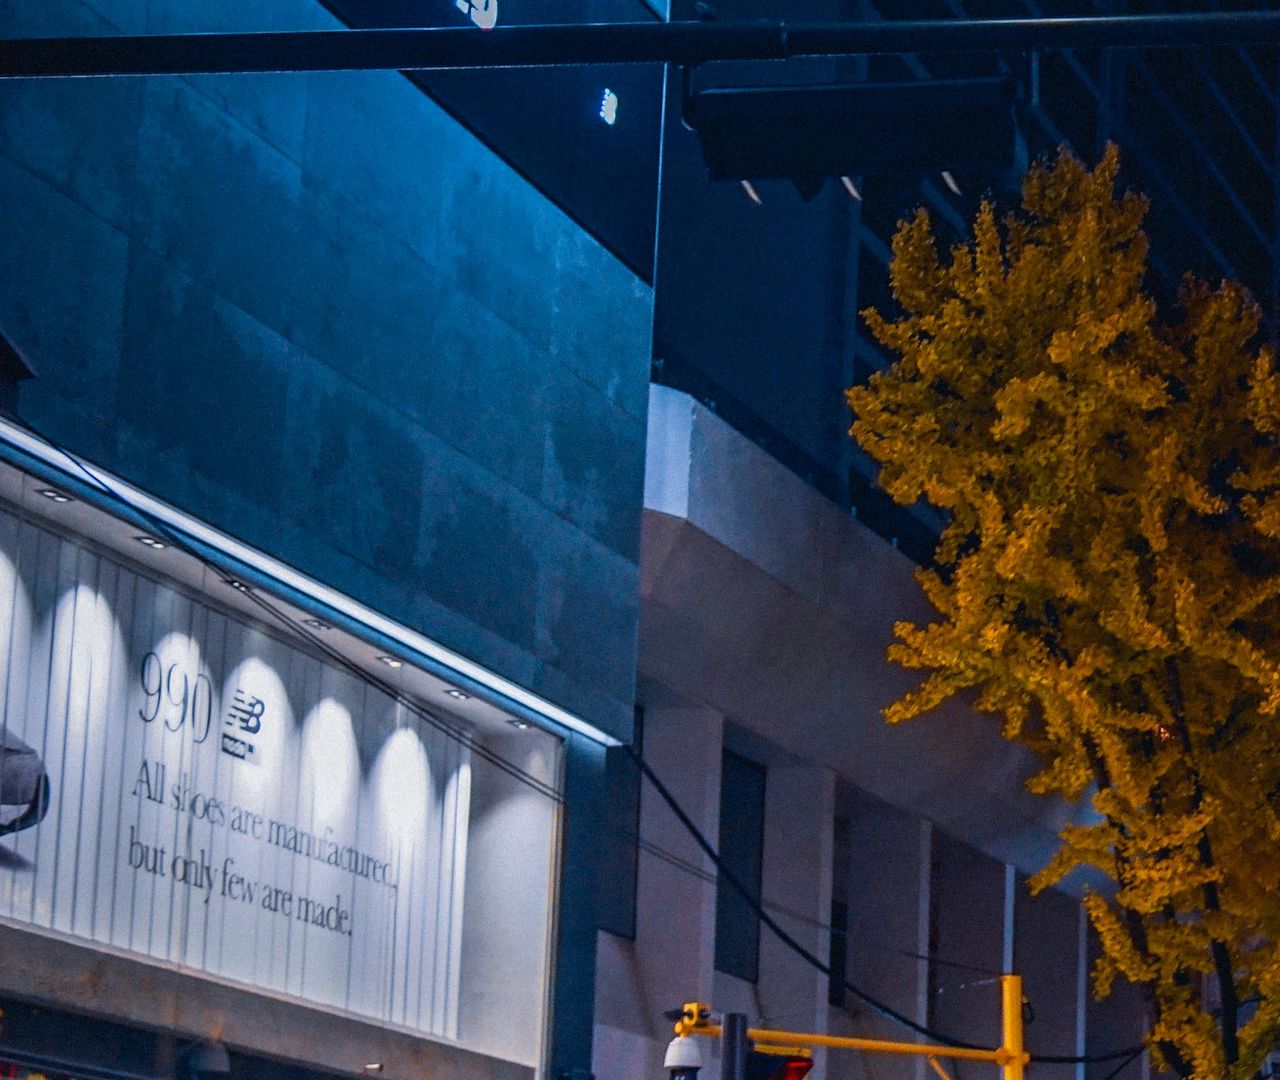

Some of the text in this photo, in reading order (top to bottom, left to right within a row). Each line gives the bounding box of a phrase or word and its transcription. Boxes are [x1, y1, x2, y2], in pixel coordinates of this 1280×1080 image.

[139, 652, 212, 743] 990
[132, 760, 165, 804] All
[171, 773, 225, 827] shoes
[231, 806, 264, 840] are
[129, 825, 352, 937] but only few are made.
